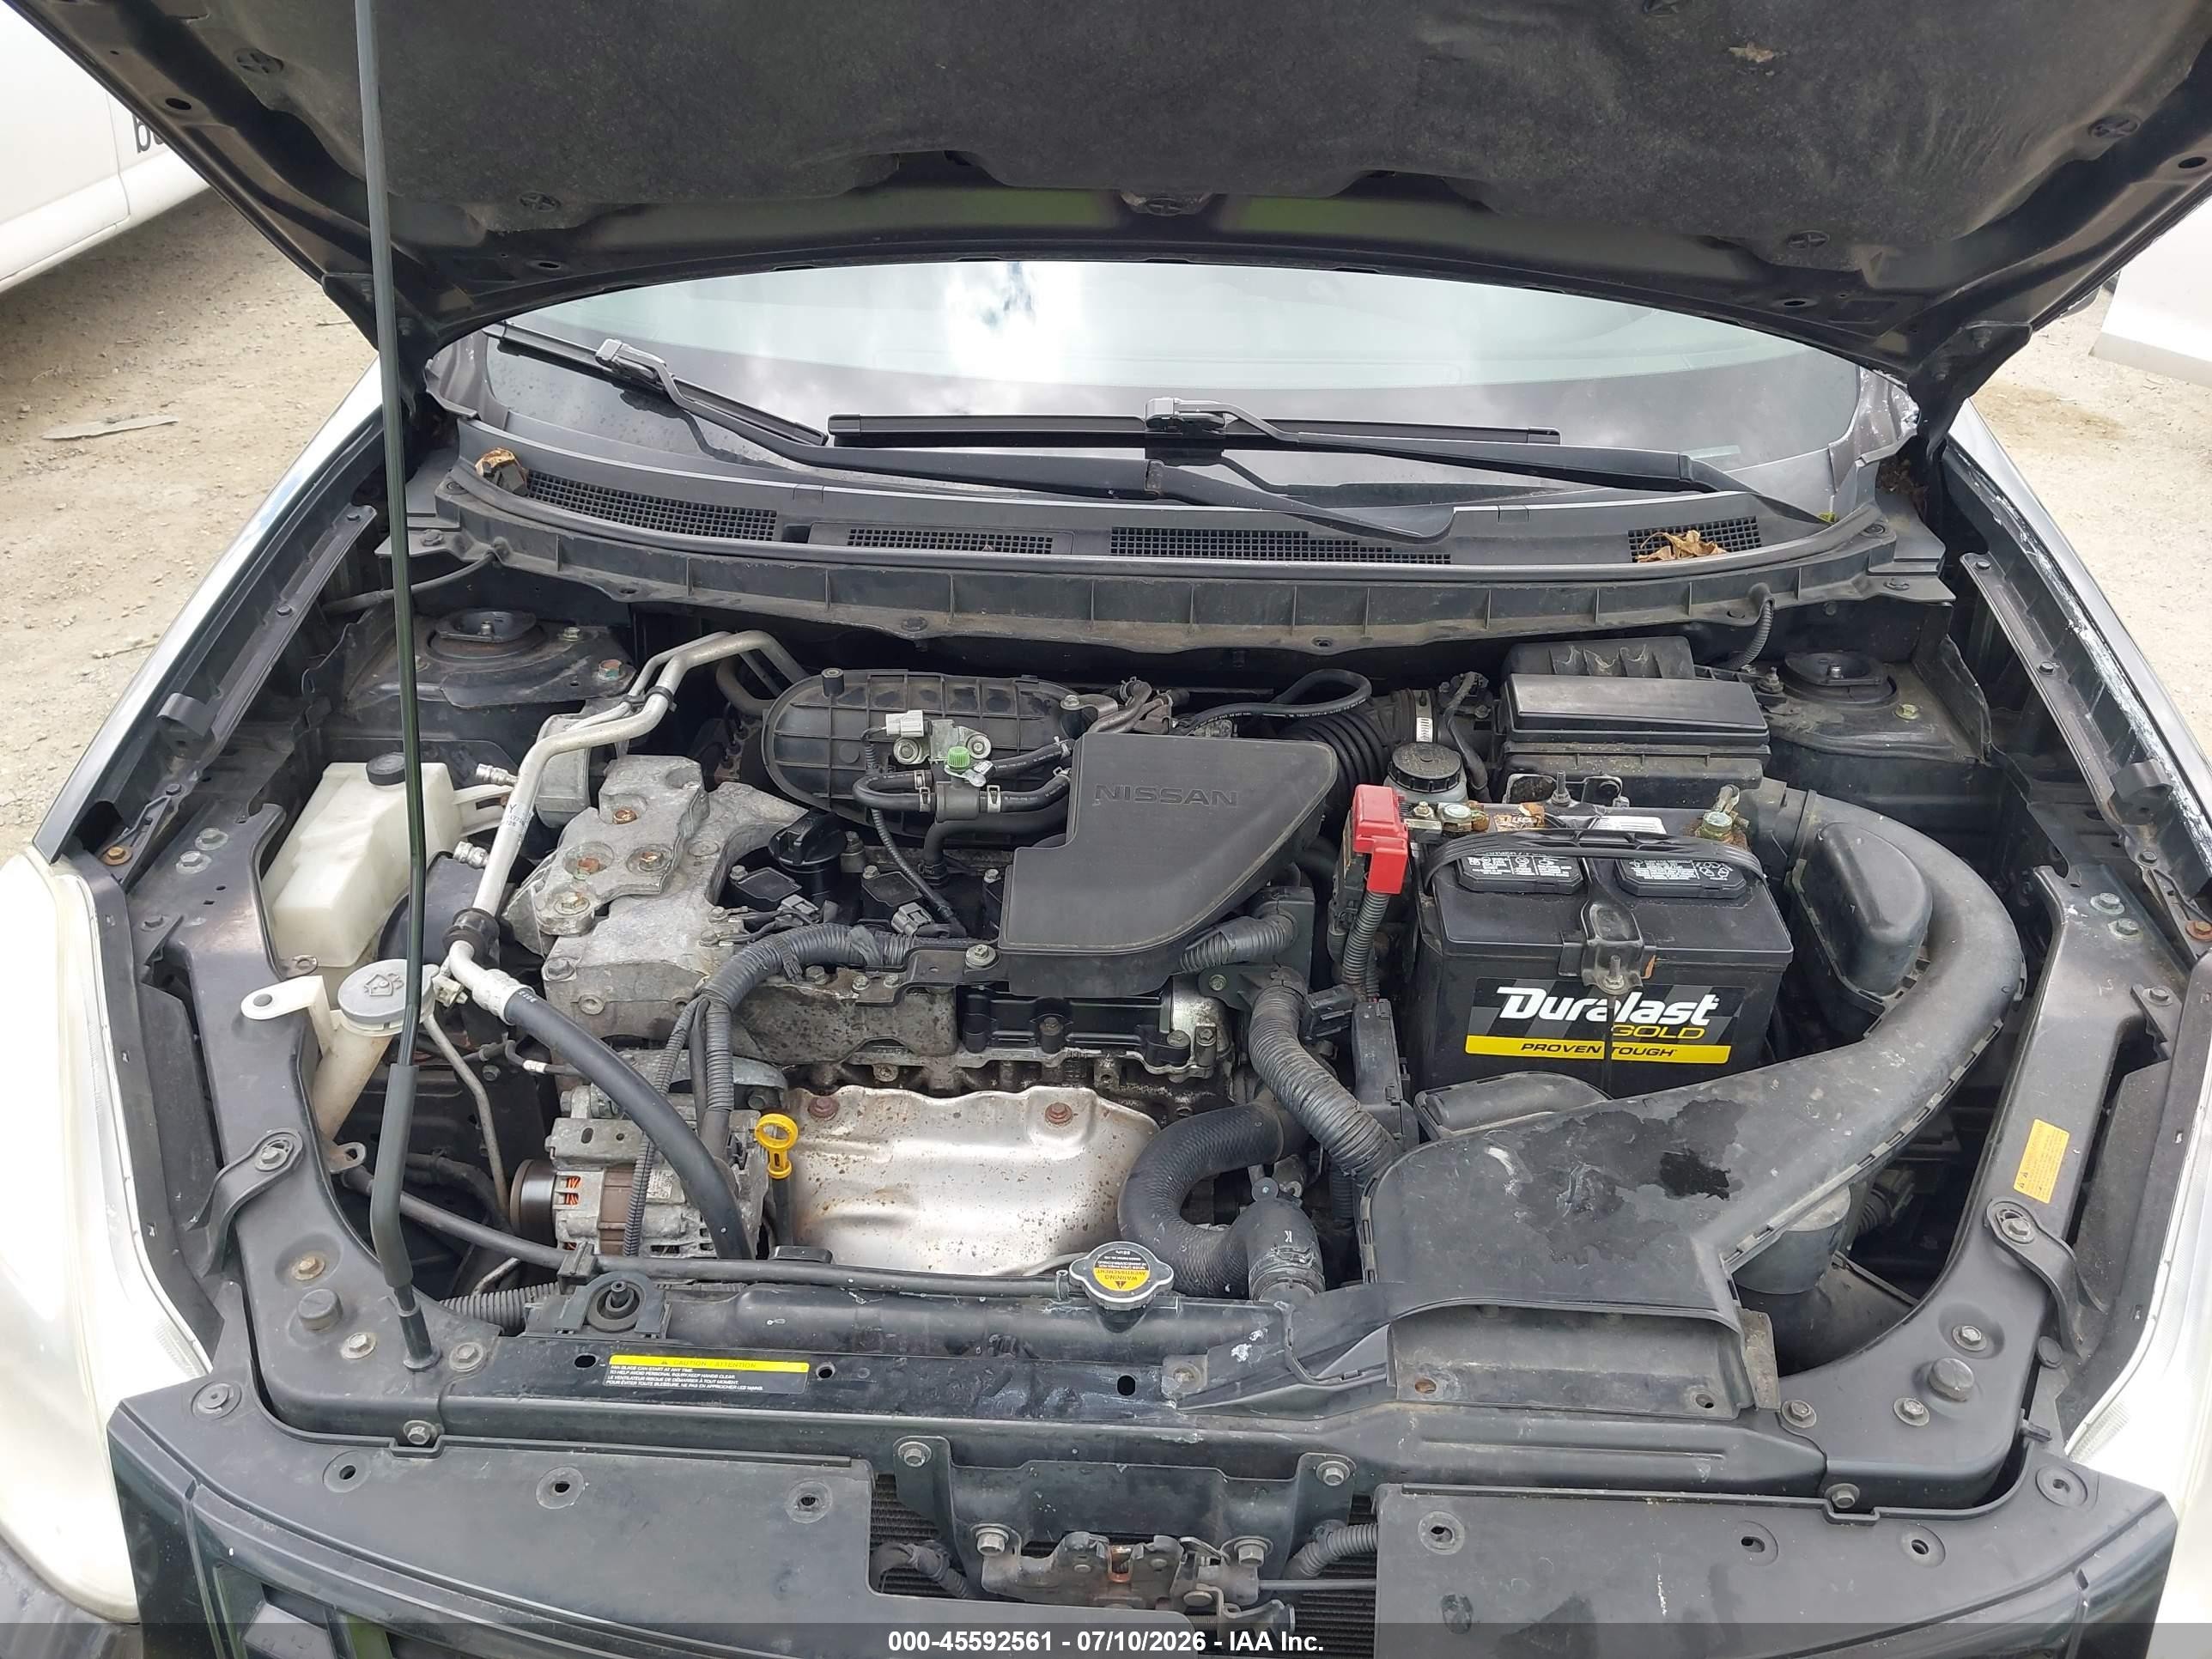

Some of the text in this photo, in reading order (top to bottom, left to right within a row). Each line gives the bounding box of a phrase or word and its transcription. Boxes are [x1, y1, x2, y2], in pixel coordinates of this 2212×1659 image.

[1095, 784, 1238, 807] NISSAN
[1497, 987, 1715, 1025] Duralast
[1611, 1025, 1705, 1038] GOLD
[1521, 1042, 1674, 1056] PROVEN TOUGH
